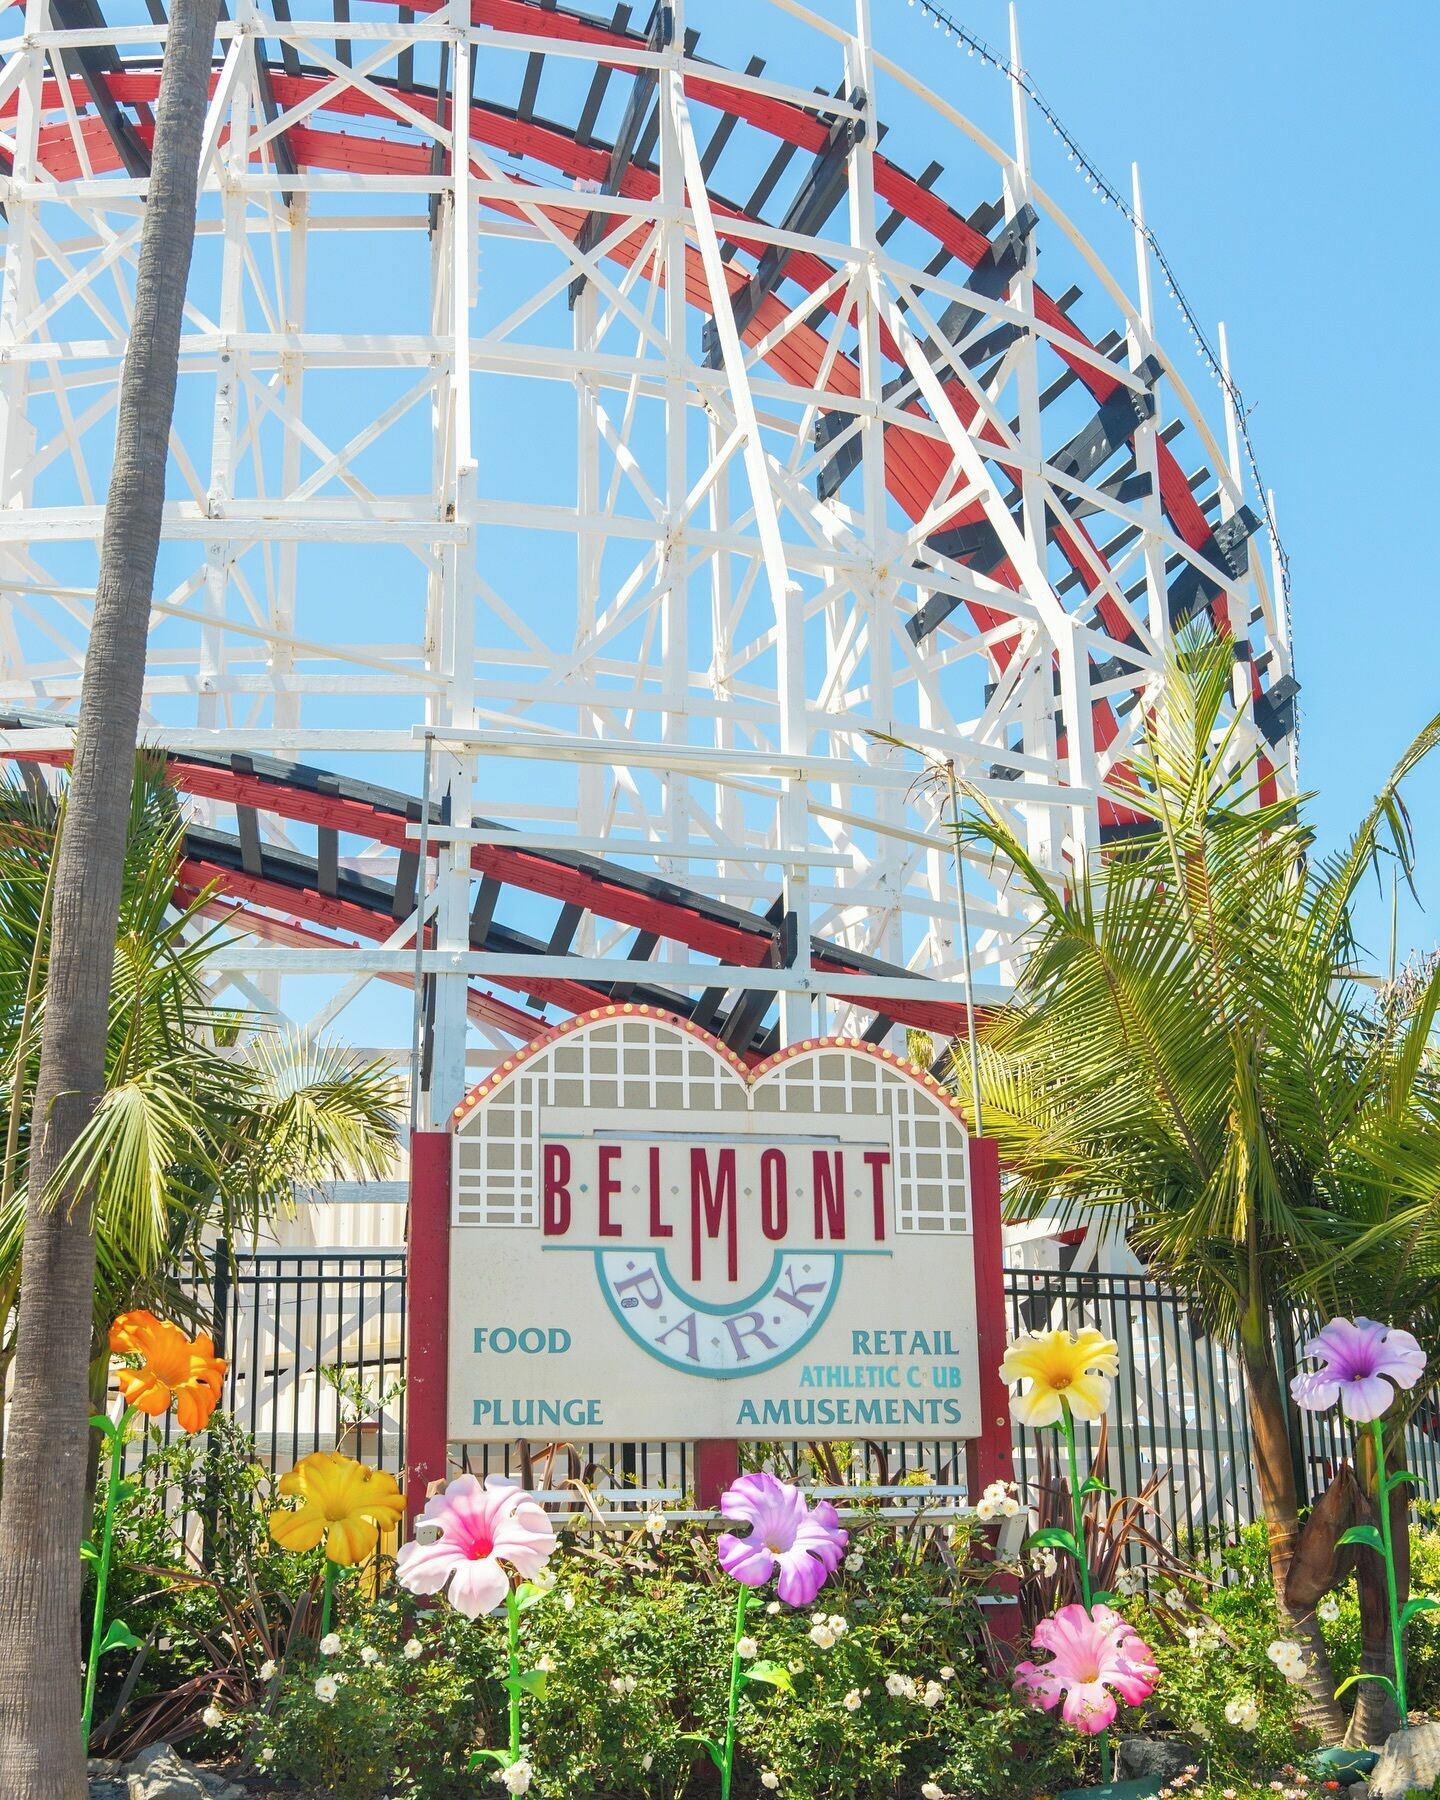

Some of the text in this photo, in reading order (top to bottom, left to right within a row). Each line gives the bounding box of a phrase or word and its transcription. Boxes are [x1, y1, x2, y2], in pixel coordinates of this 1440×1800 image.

[543, 1143, 891, 1282] BELMONT
[613, 1264, 827, 1362] PARK
[473, 1327, 572, 1354] FOOD
[852, 1330, 960, 1356] RETAIL
[799, 1366, 962, 1388] ATHLETIC CUB
[472, 1399, 604, 1426] PLUNGE
[736, 1398, 962, 1425] AMUSEMENTS
